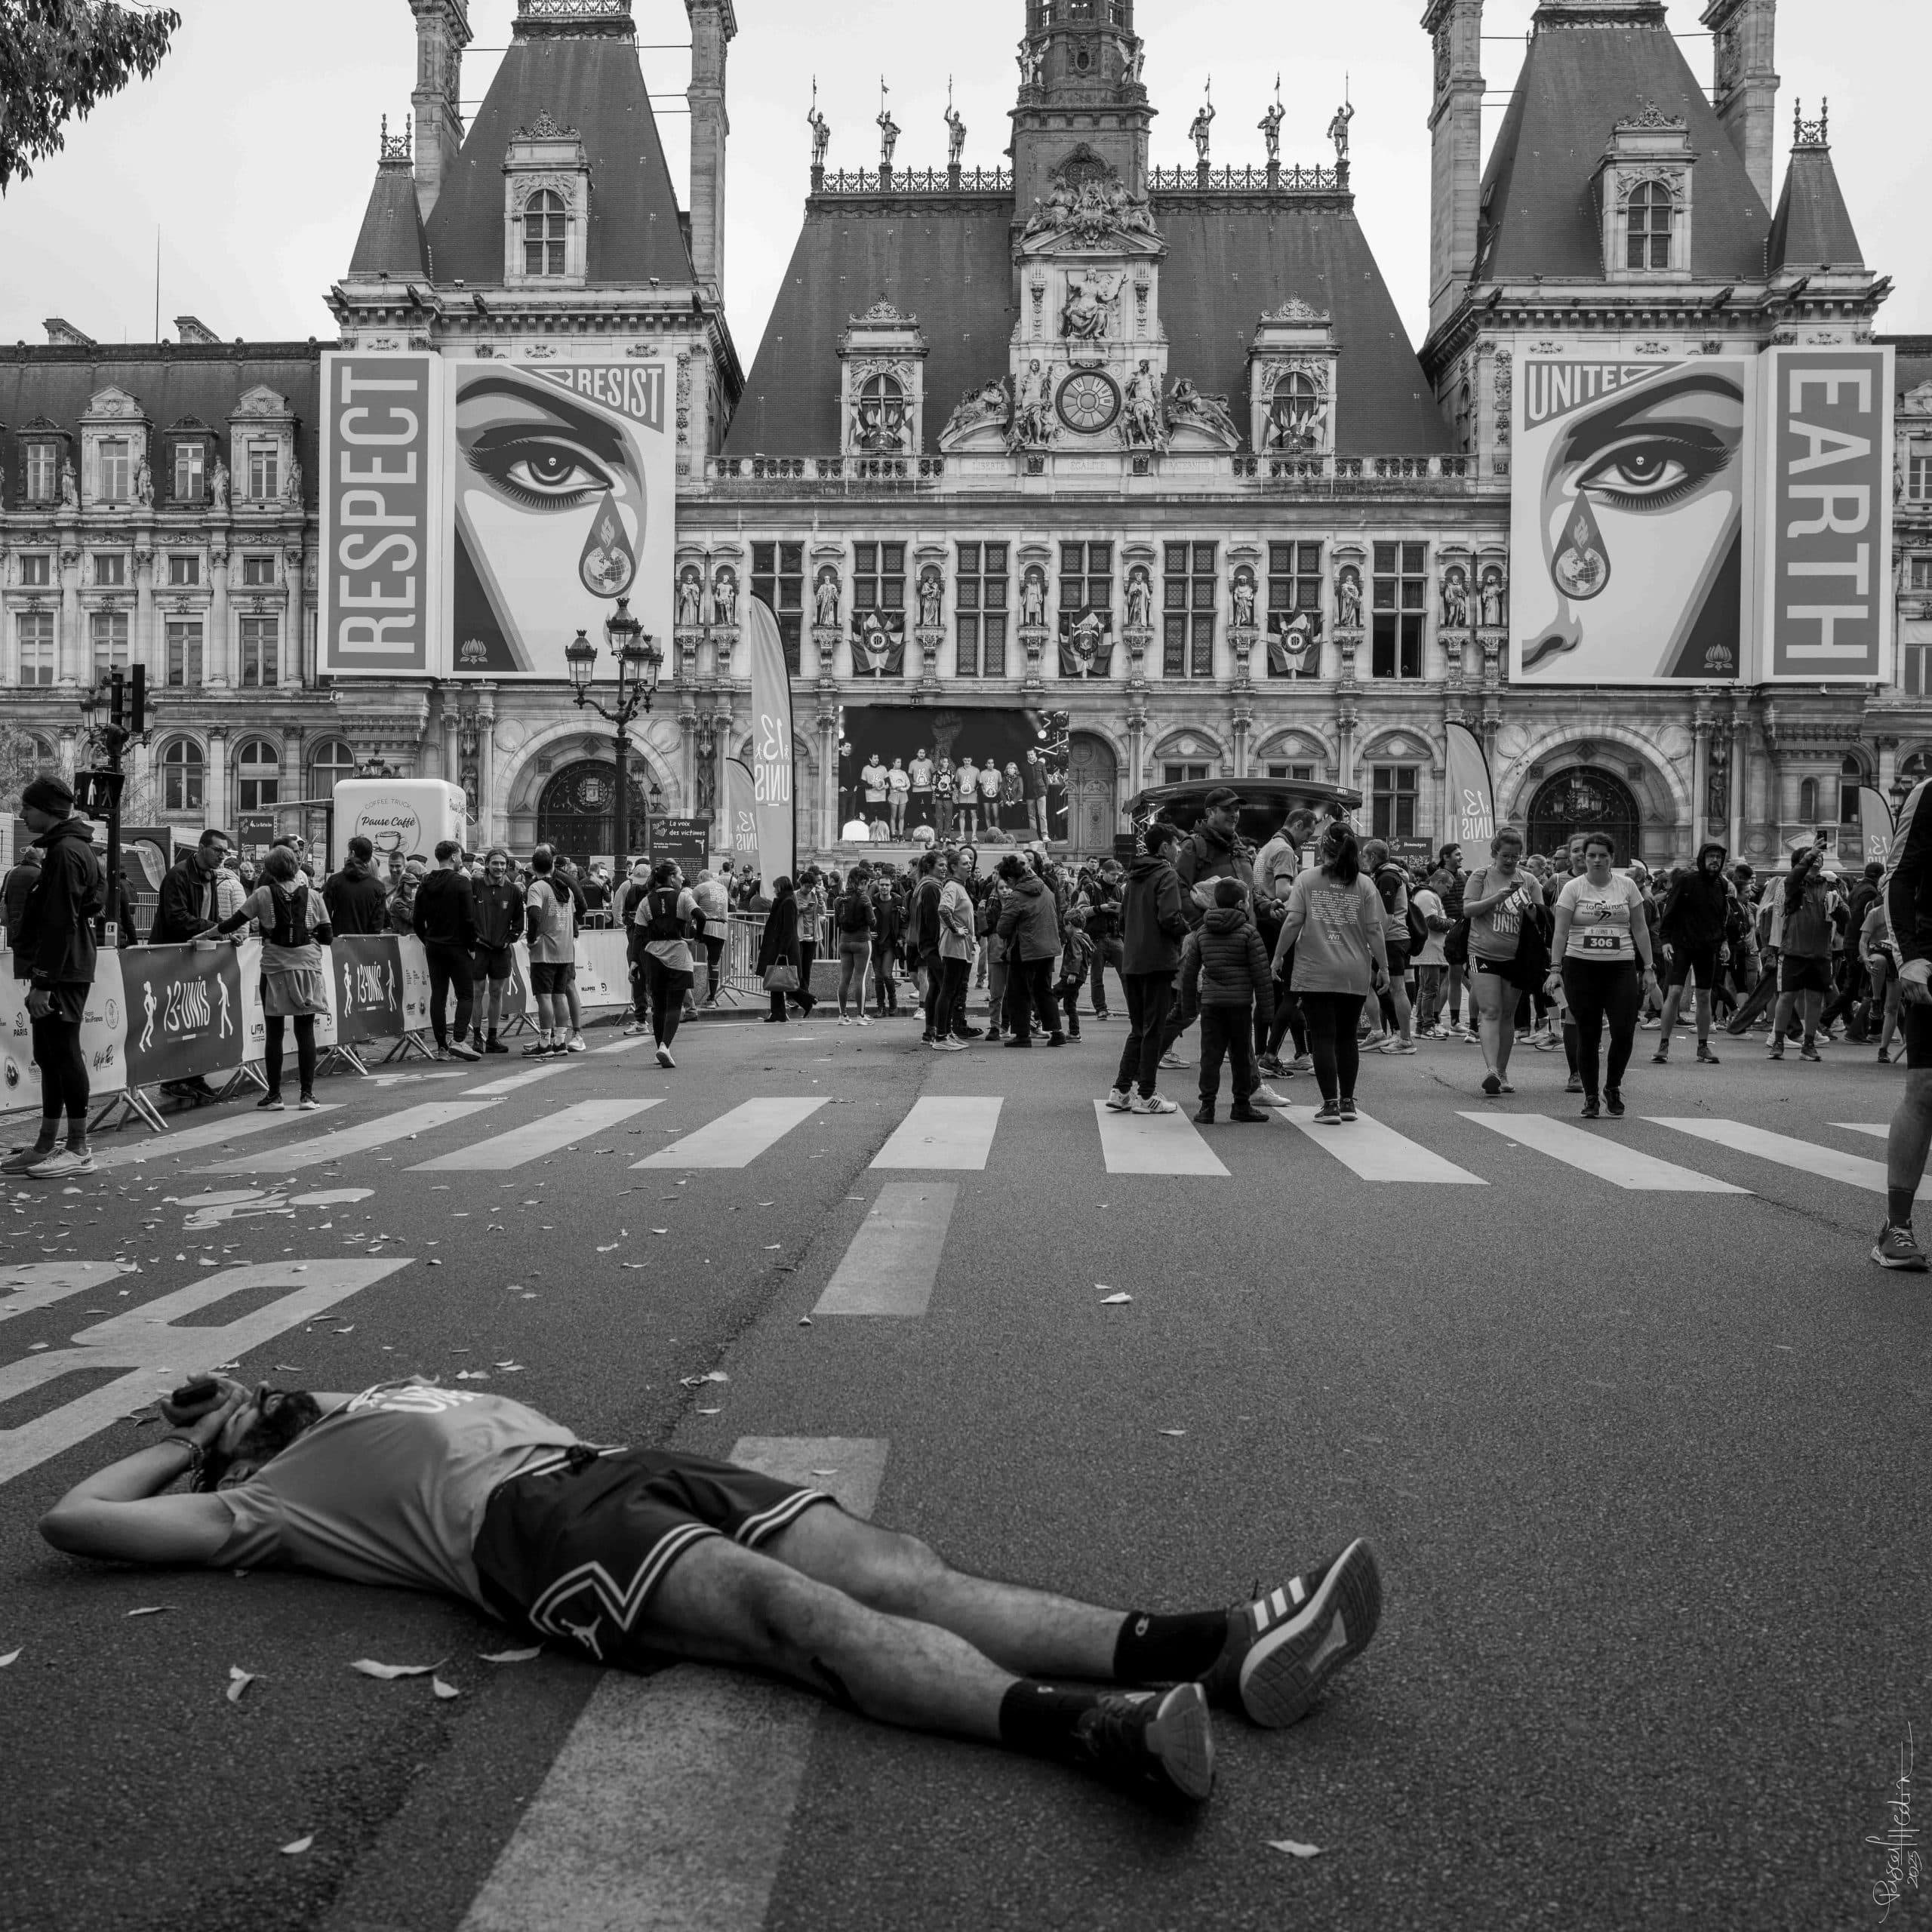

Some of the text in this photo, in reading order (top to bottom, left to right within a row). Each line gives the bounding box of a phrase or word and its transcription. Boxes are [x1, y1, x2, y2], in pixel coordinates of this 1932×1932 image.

[578, 368, 663, 423] RESIST
[1528, 365, 1617, 420] UNITE
[338, 366, 419, 654] RESPECT
[1786, 368, 1872, 659] EARTH
[365, 798, 411, 810] COFFEE TRUCK
[361, 817, 416, 828] Pause Caffè
[1493, 913, 1520, 934] UNIS
[1590, 938, 1613, 947] 306
[13, 1029, 28, 1037] PARIS
